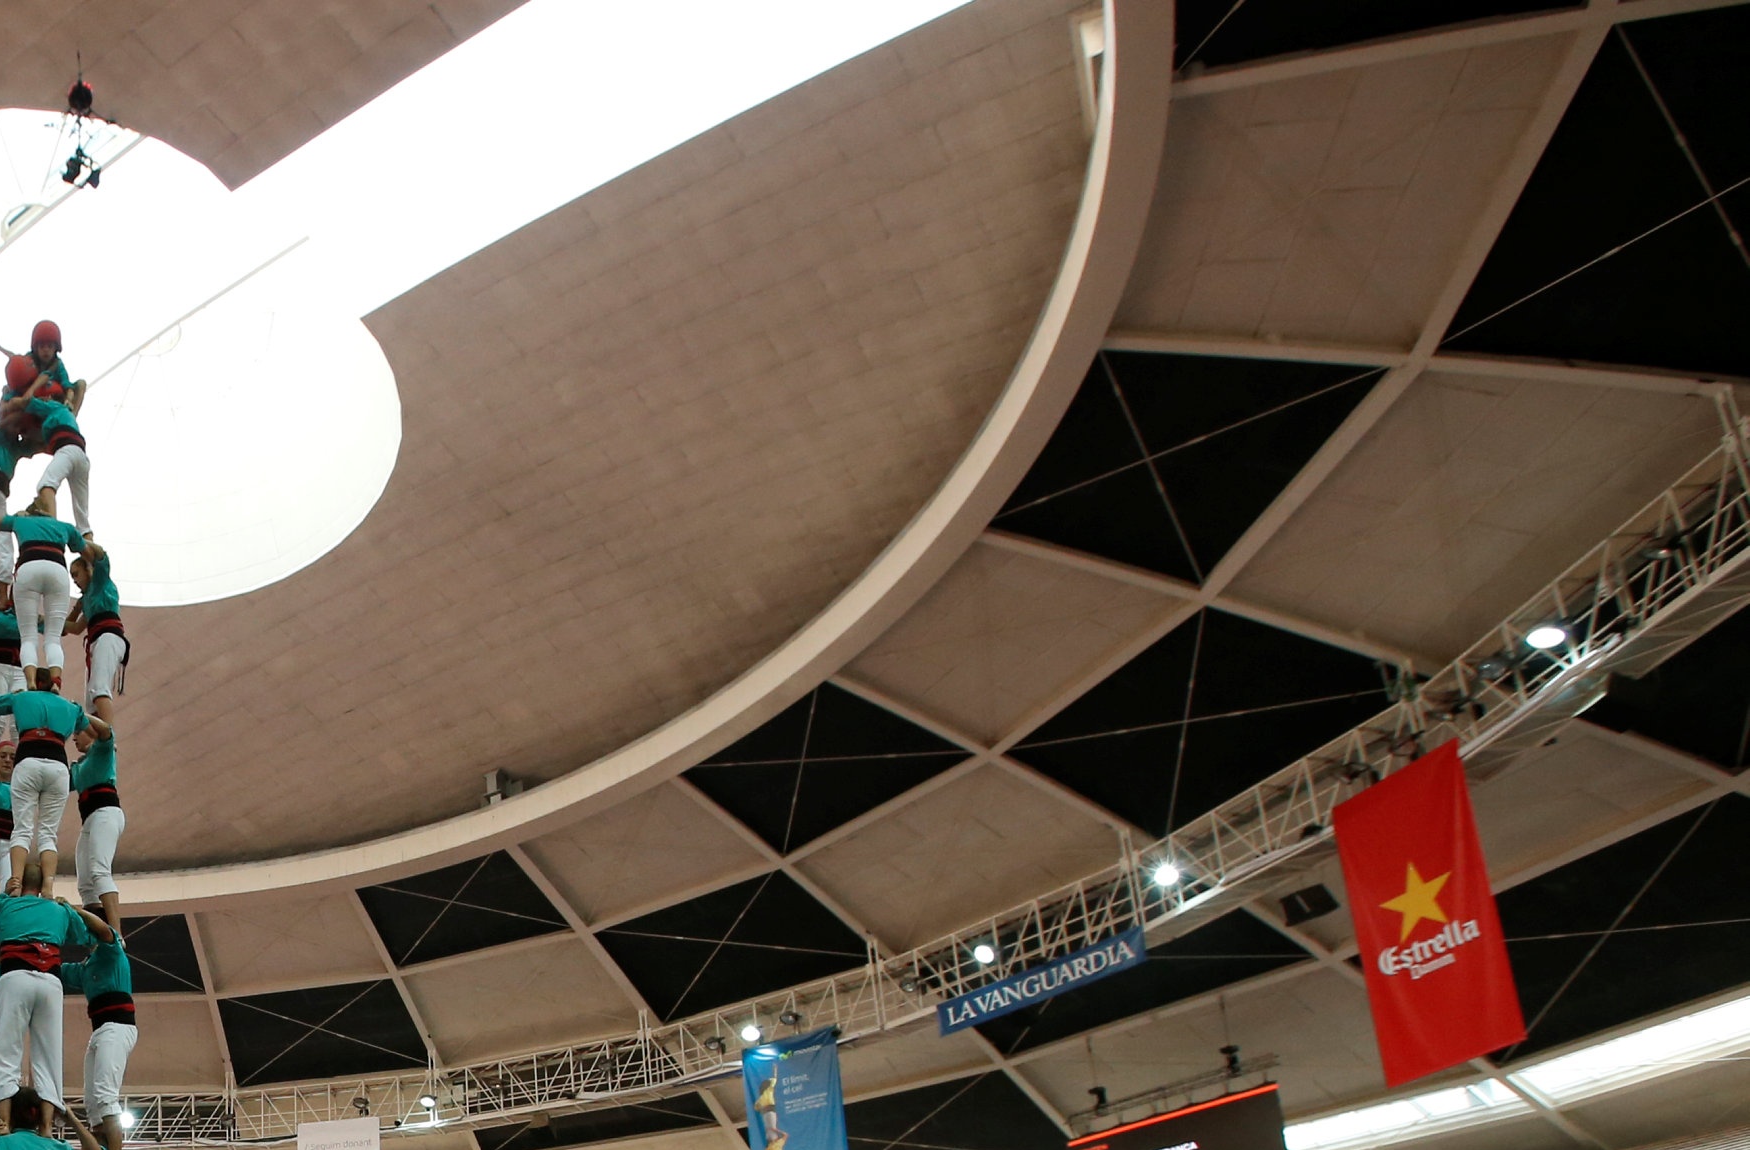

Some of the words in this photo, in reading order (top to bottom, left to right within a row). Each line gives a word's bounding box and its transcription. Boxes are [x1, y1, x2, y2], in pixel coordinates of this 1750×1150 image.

[1377, 917, 1481, 976] Estrella
[946, 1000, 977, 1026] LA
[975, 940, 1136, 1014] VANGUARDIA
